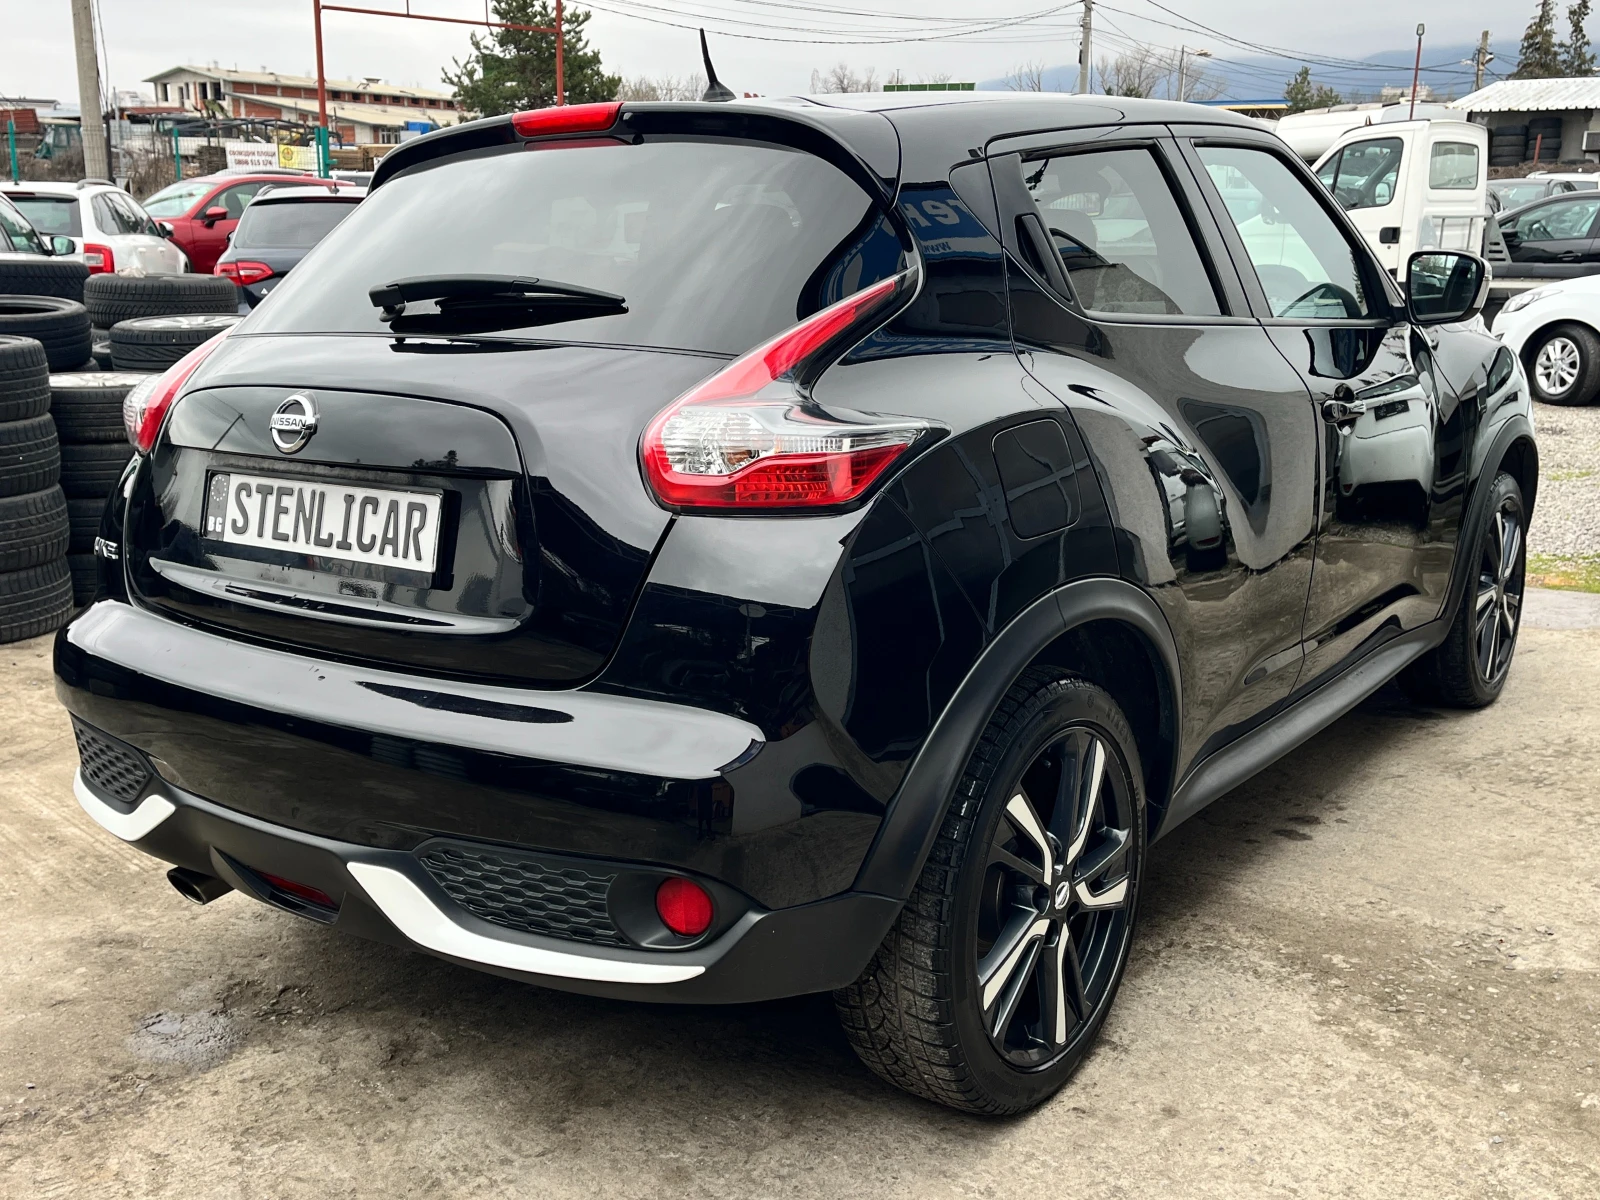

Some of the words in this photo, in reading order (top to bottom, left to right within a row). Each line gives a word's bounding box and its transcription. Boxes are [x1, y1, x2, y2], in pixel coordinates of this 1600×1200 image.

[271, 417, 307, 428] NISSAN
[207, 515, 223, 533] BG
[230, 482, 428, 561] STENLICAR
